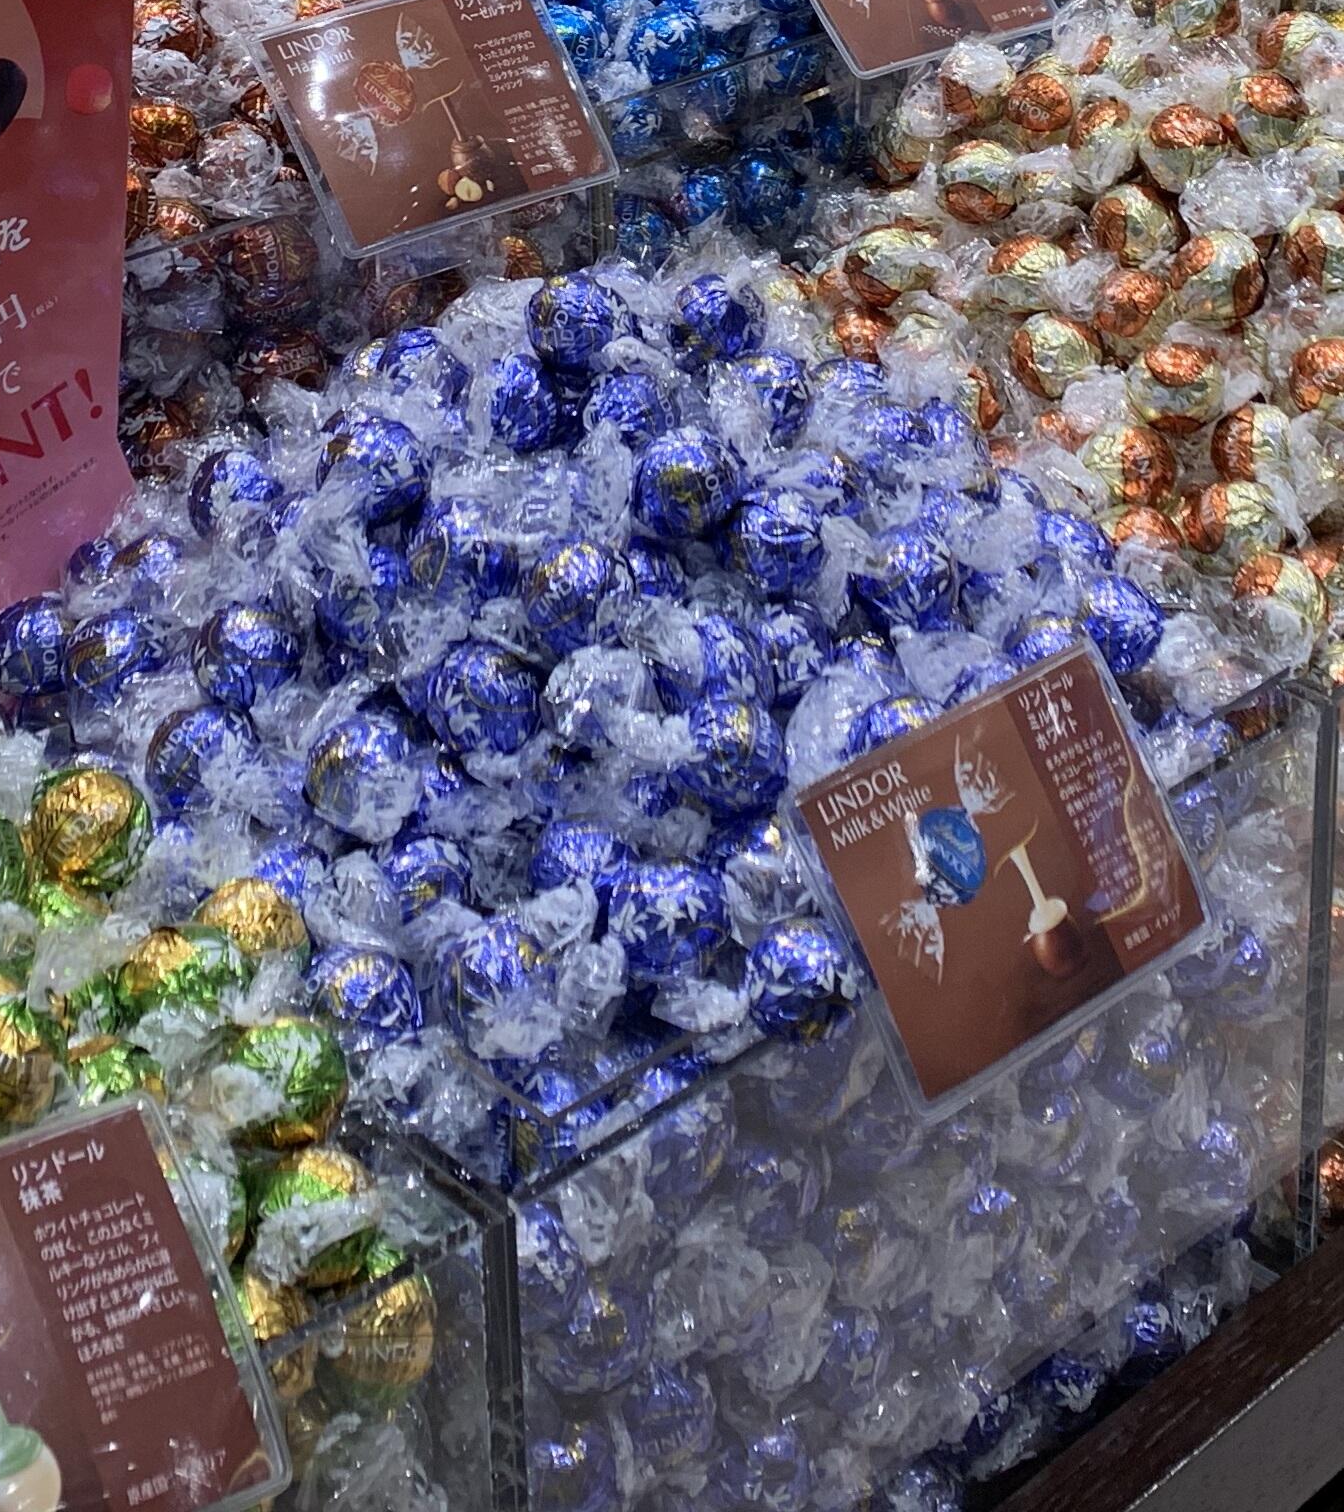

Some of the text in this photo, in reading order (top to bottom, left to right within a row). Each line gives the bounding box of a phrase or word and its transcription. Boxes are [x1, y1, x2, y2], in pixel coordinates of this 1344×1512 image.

[460, 0, 524, 23] ヘーゼルナッツ
[276, 24, 356, 62] LINDOR
[285, 49, 356, 78] Hanut
[256, 224, 281, 282] LINDOR
[1018, 670, 1075, 712] リンドール
[816, 760, 909, 825] LINDOR
[10, 1139, 106, 1186] リンドール
[17, 1178, 65, 1217] 抹茶
[32, 1190, 146, 1245] ホワイトチョコレート
